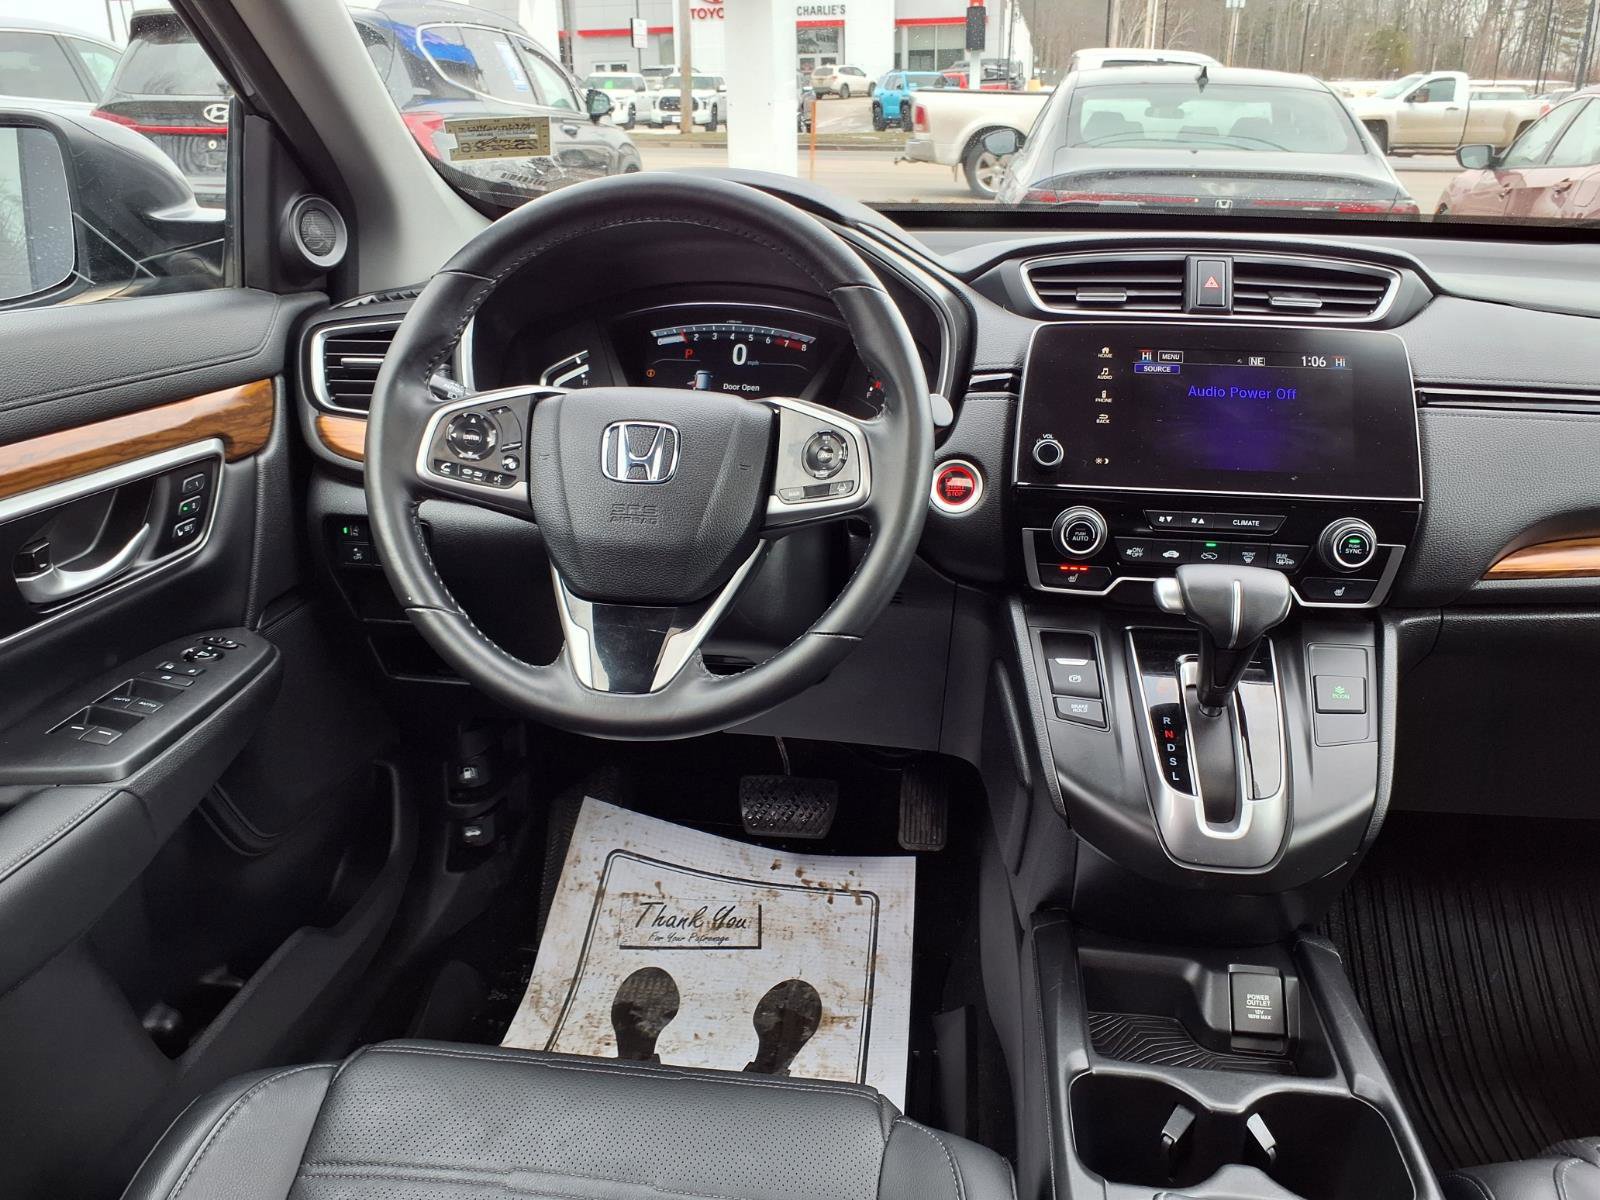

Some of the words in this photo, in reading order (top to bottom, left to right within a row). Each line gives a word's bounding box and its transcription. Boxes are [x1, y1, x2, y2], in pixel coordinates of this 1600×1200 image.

[796, 4, 846, 17] CHARLIE'S
[693, 333, 699, 342] 2
[711, 332, 718, 341] 3
[729, 332, 736, 341] 4
[748, 333, 754, 342] 5
[765, 335, 771, 345] 6
[783, 339, 790, 348] 7
[801, 343, 807, 352] 8
[685, 349, 694, 359] P
[732, 343, 747, 366] 0
[1161, 352, 1181, 361] MENU
[1250, 357, 1264, 367] NE
[1301, 355, 1327, 368] 1:06
[1143, 364, 1171, 373] SOURCE
[722, 383, 740, 392] Door
[741, 384, 760, 393] Open
[1188, 384, 1226, 398] Audio
[1230, 386, 1271, 399] Power
[1276, 387, 1297, 400] Off
[1232, 519, 1260, 527] CLIMATE
[1162, 716, 1171, 725] R
[1164, 729, 1174, 739] N
[1166, 743, 1176, 752] D
[1169, 757, 1178, 766] S
[1172, 771, 1180, 781] L
[635, 902, 708, 929] Thank
[712, 905, 747, 931] You
[648, 931, 664, 942] For
[665, 932, 686, 943] Your
[688, 932, 730, 945] Patronage
